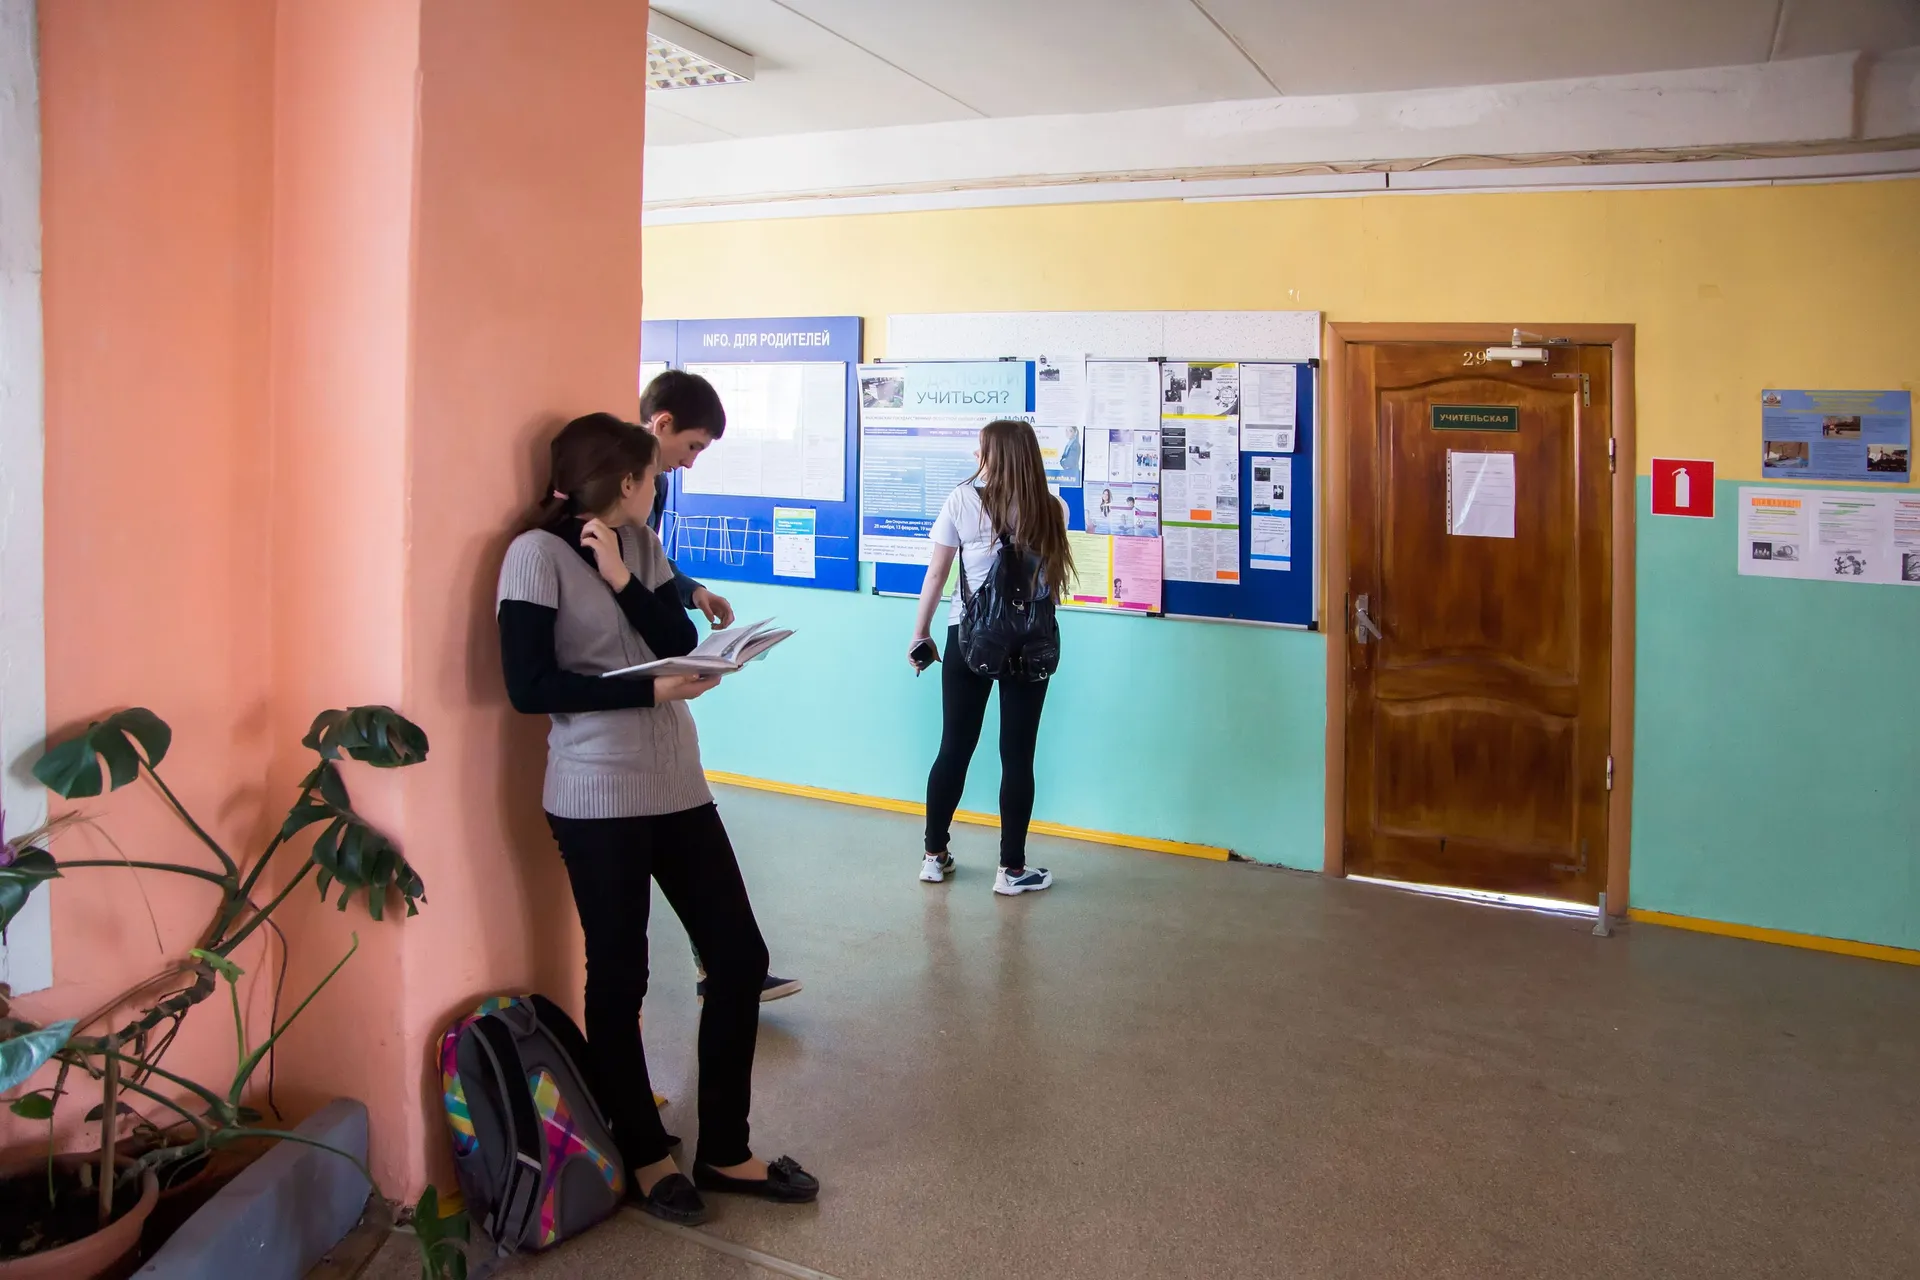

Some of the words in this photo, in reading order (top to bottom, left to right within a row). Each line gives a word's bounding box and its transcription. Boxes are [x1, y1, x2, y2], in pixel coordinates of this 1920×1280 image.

[703, 333, 731, 347] INFO.
[733, 333, 757, 348] ДЛЯ
[760, 330, 830, 348] РОДИТЕЛЕЙ
[1463, 350, 1487, 366] 29
[916, 390, 1010, 404] УЧИТЬСЯ?
[1440, 414, 1508, 422] УЧИТЕЛЬСКАЯ
